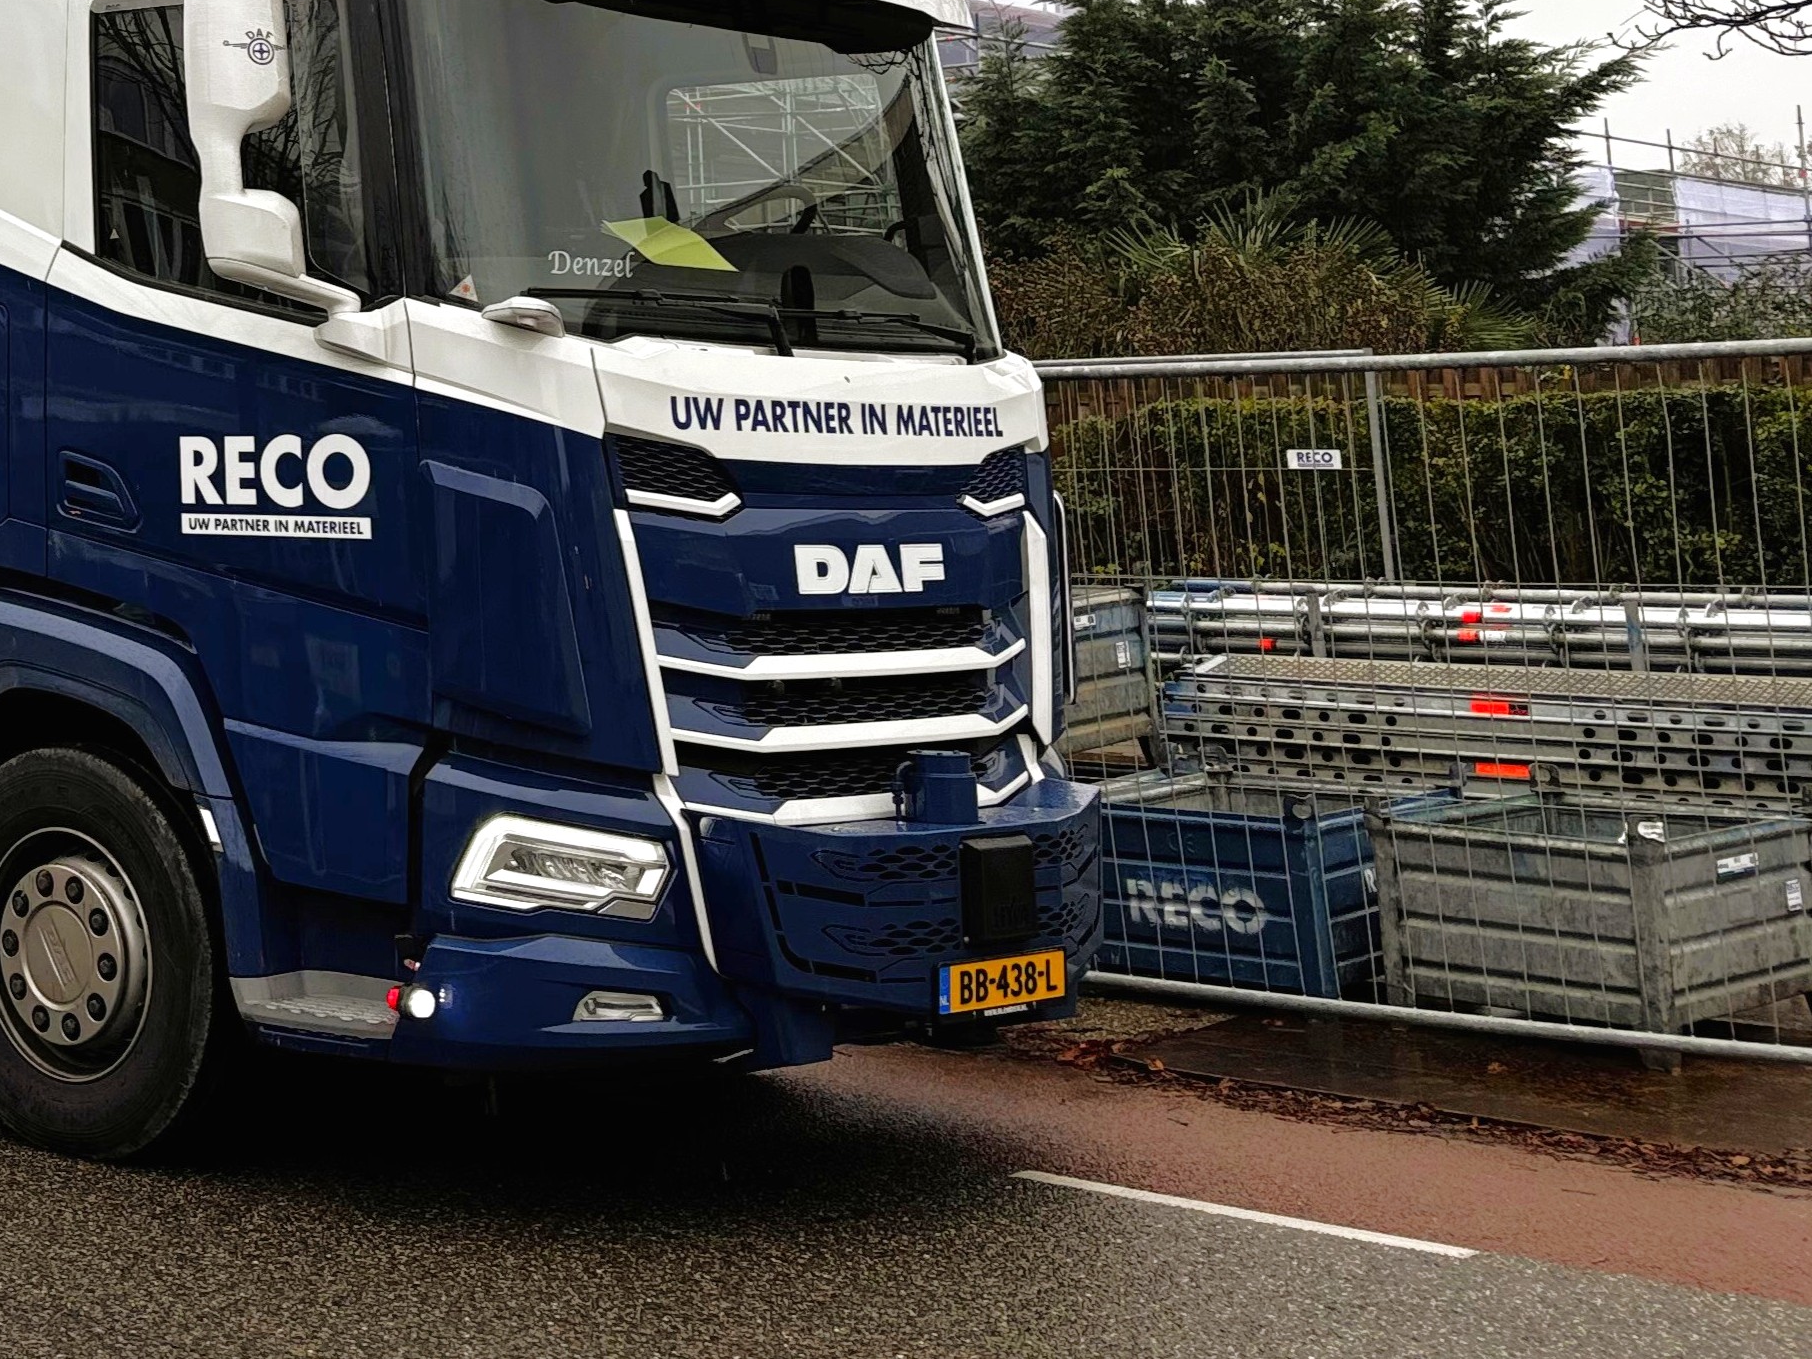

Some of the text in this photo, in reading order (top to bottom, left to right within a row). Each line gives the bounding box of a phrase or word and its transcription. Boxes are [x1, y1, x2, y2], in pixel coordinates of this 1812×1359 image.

[245, 27, 274, 40] DAF
[548, 250, 635, 278] Denzel
[670, 395, 1004, 438] UW PARTNER IN MATERIEEL
[179, 433, 371, 510] RECO
[1296, 451, 1333, 463] RECO
[188, 517, 364, 535] UW PARTNER IN MATERIEEL
[793, 542, 946, 596] DAF
[1125, 877, 1268, 935] RECO
[959, 958, 1058, 1005] BB-438-L
